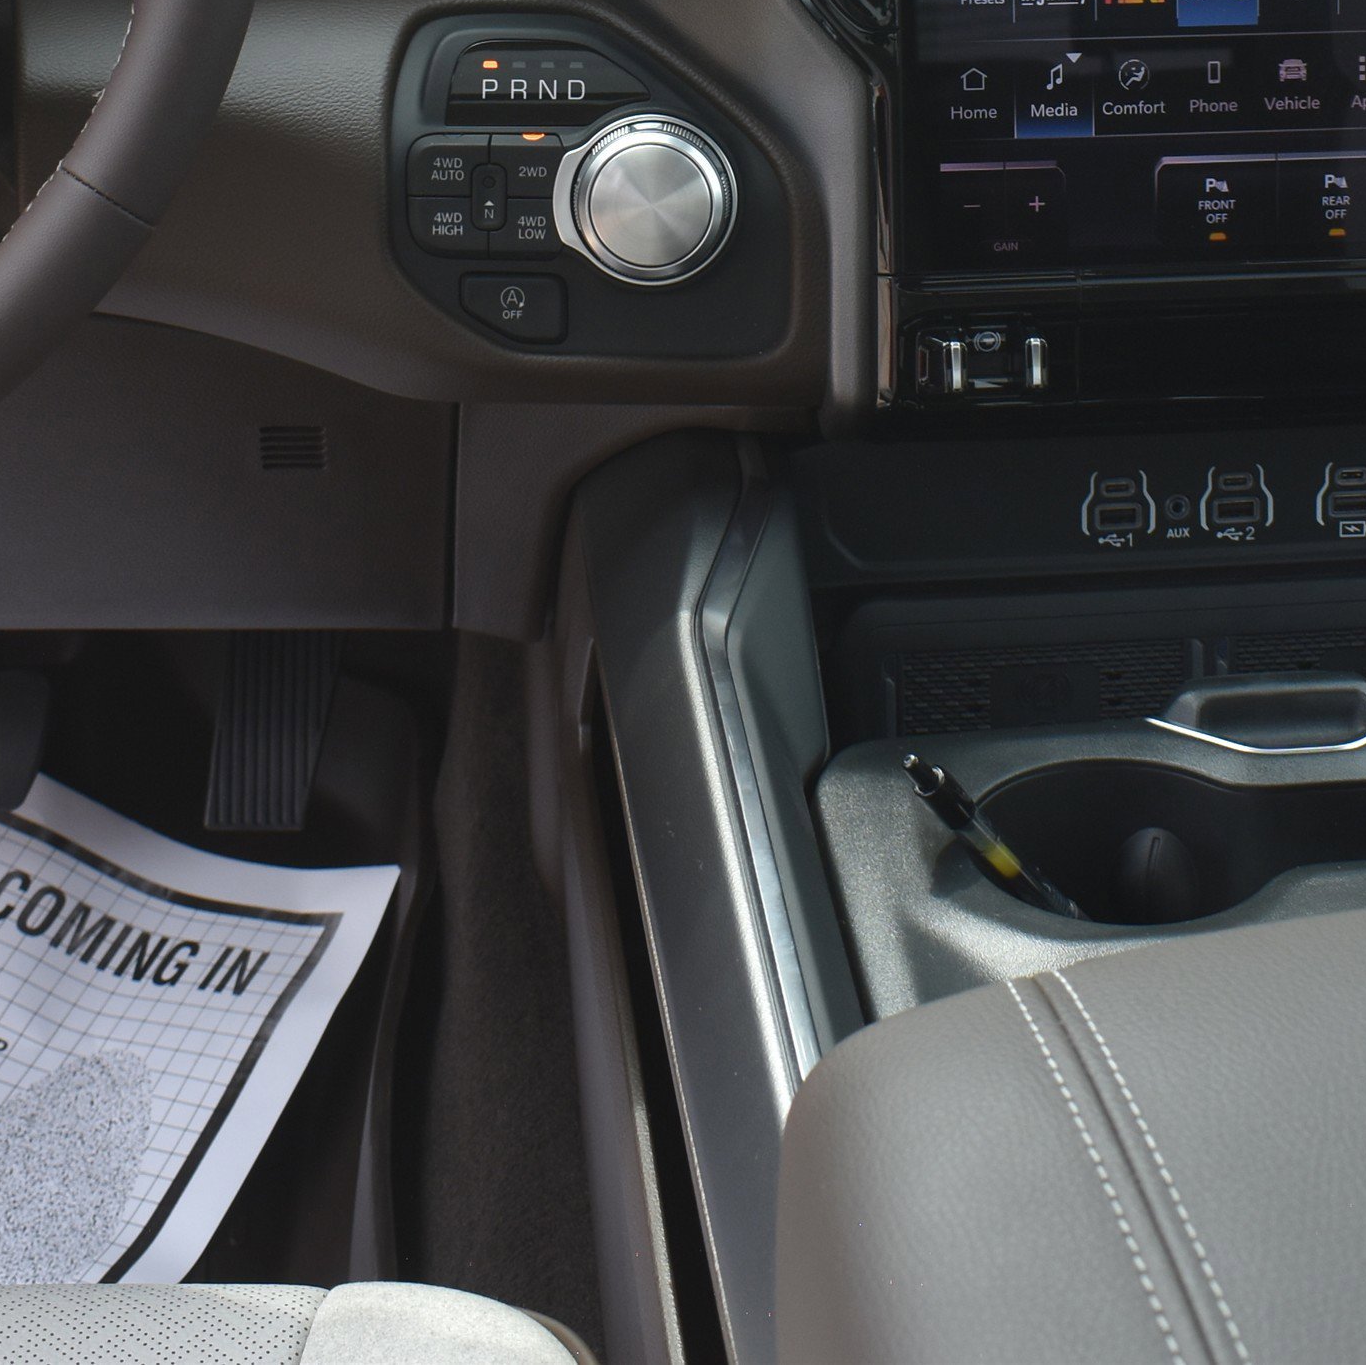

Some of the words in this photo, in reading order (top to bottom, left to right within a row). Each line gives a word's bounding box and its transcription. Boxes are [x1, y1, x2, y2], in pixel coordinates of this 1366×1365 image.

[482, 80, 499, 100] P
[511, 80, 527, 100] R
[538, 80, 558, 100] N
[567, 80, 586, 100] D
[1102, 100, 1166, 116] Comfort
[1189, 98, 1238, 113] Phone
[1264, 96, 1321, 111] Vehicle
[951, 106, 997, 120] Home
[1031, 103, 1078, 117] Media
[433, 157, 463, 169] 4WD
[431, 169, 464, 181] AUTO
[518, 166, 547, 178] 2WD
[1198, 199, 1235, 212] FRONT
[1322, 195, 1350, 207] REAR
[434, 212, 463, 224] 4WD
[484, 208, 495, 220] N
[1205, 212, 1228, 224] OFF
[1325, 208, 1347, 221] OFF
[517, 215, 546, 227] 4WD
[432, 224, 464, 236] HIGH
[518, 227, 546, 240] LOW
[993, 241, 1019, 253] GAIN
[502, 309, 523, 320] OFF
[1166, 528, 1191, 540] AUX
[1245, 526, 1256, 541] 2
[1126, 533, 1134, 547] 1
[199, 945, 271, 996] IN
